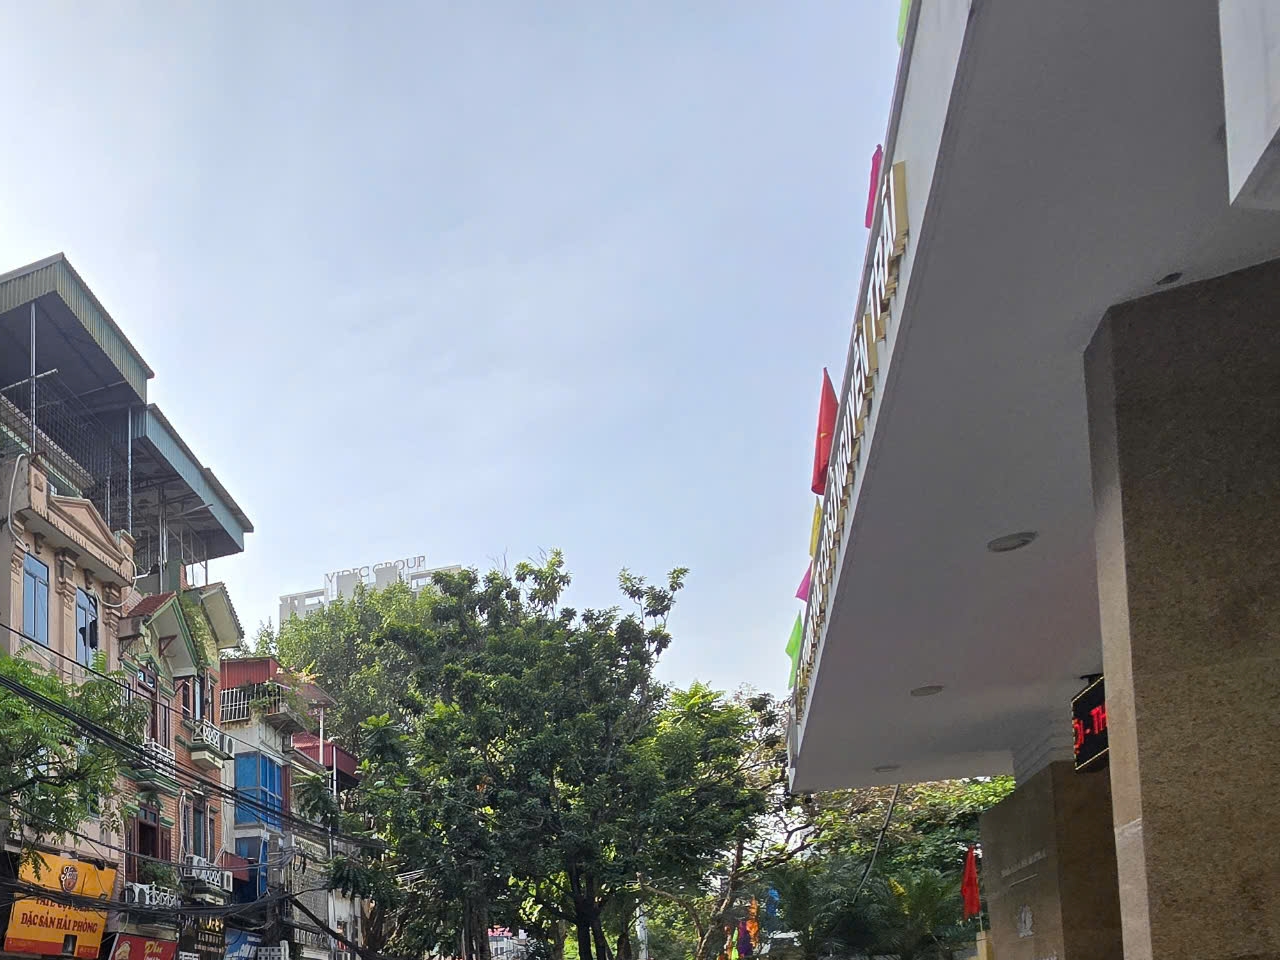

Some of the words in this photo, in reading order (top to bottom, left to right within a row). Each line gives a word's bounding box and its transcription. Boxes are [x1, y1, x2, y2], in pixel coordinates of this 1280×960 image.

[868, 165, 897, 343] TRÃI
[21, 911, 39, 927] ĐẶC
[39, 912, 55, 929] SẢN
[56, 914, 71, 931] HẢI
[72, 917, 99, 934] PHÒNG
